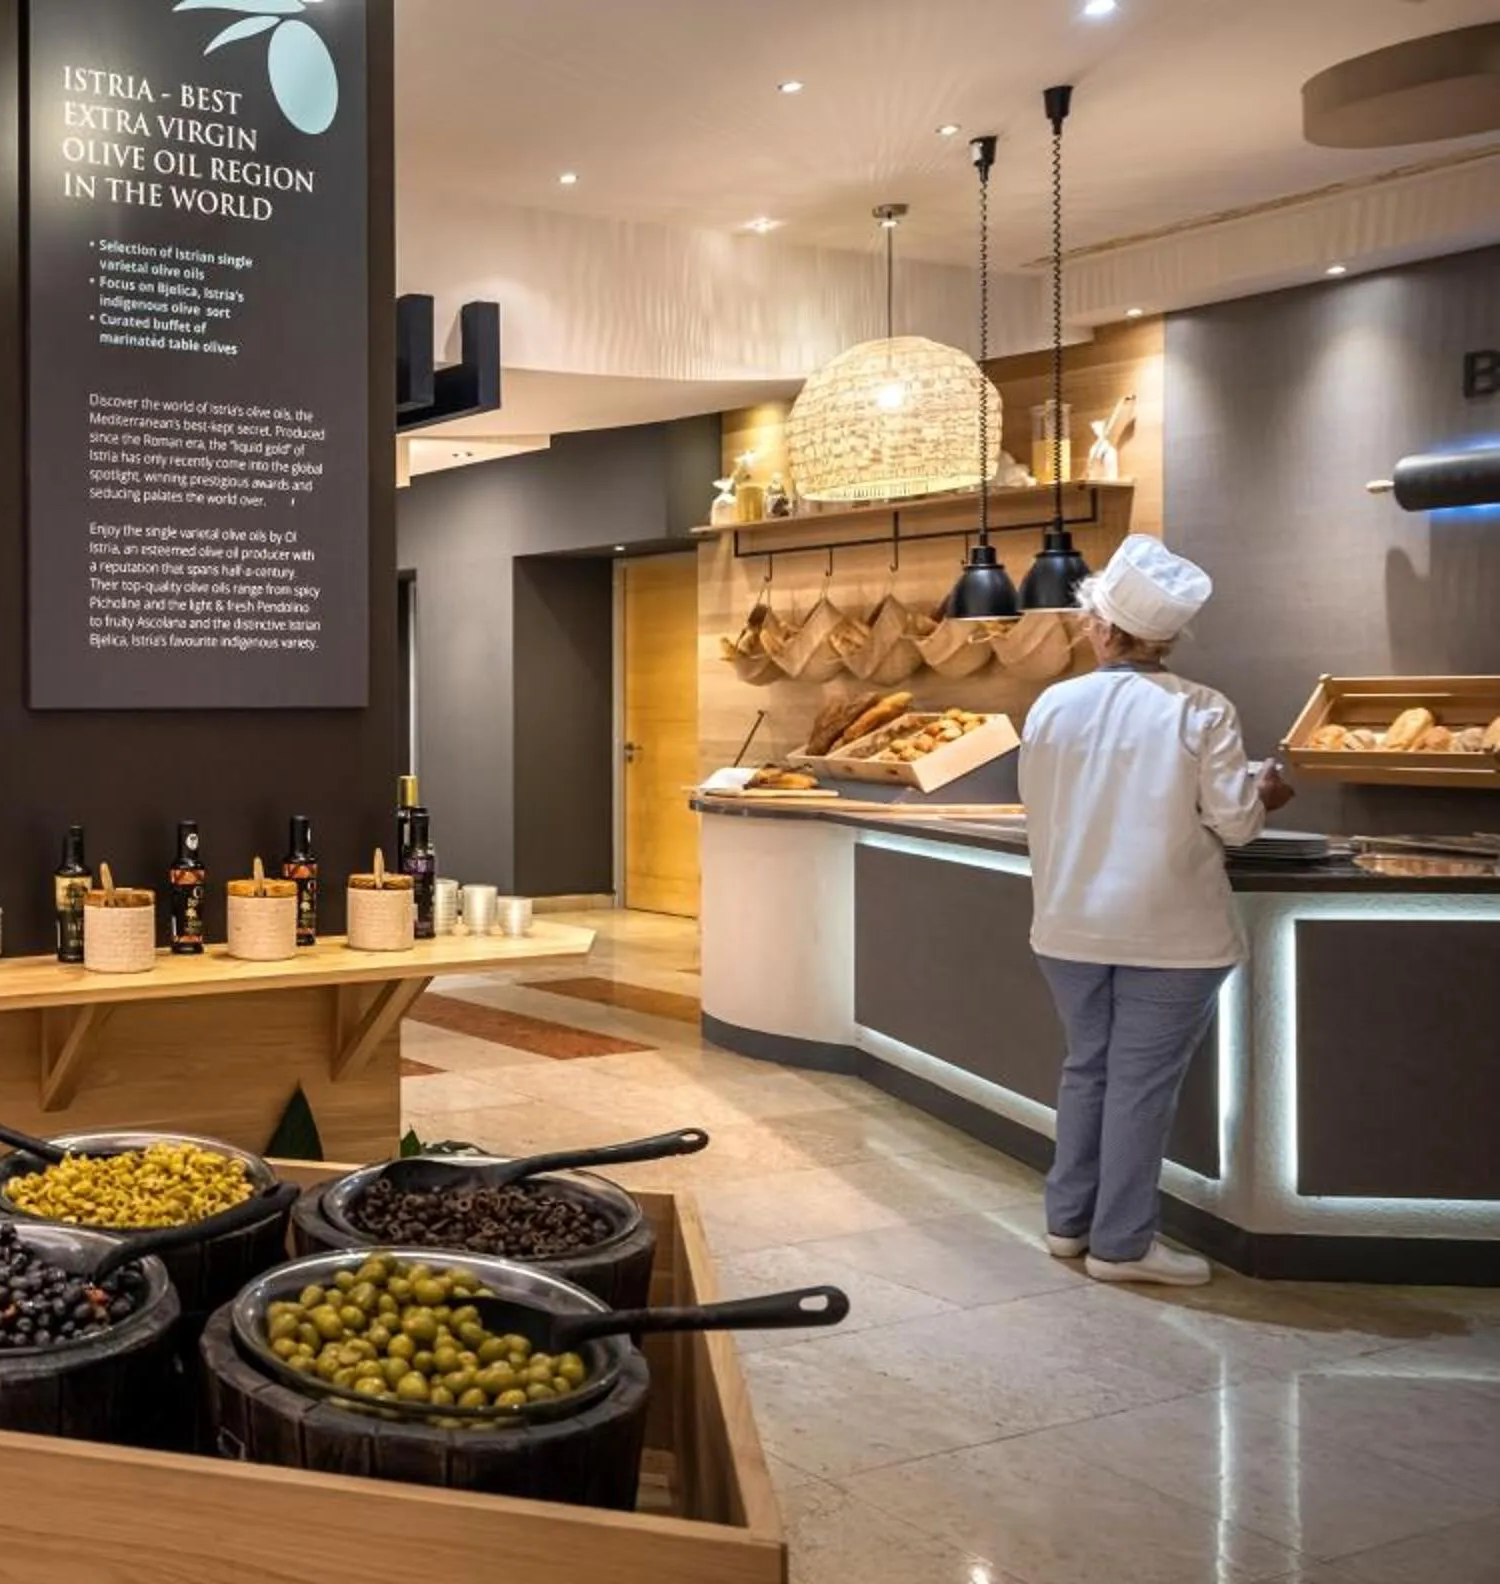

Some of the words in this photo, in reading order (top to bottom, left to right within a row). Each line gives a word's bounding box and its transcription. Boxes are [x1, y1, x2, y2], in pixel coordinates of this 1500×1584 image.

[63, 67, 153, 102] ISTRIA
[180, 83, 243, 114] BEST
[63, 102, 151, 136] EXTRA
[157, 114, 258, 151] VIRGIN
[61, 138, 145, 171] OLIVE
[153, 150, 203, 179] OIL
[210, 157, 314, 192] REGION
[63, 173, 95, 200] IN
[105, 178, 163, 208] THE
[169, 186, 272, 220] WORLD
[99, 239, 157, 257] Selection
[159, 246, 173, 259] of
[175, 247, 214, 264] Istrian
[217, 252, 253, 269] single
[99, 259, 148, 274] varietal
[151, 263, 180, 277] olive
[183, 266, 205, 280] oils
[99, 275, 135, 291] Focus
[138, 282, 154, 293] on
[157, 281, 201, 299] Bjelica,
[99, 294, 168, 312] indigenous
[171, 301, 200, 315] olive
[206, 306, 231, 318] sort
[99, 312, 150, 329] Curated
[153, 316, 191, 332] buffet
[193, 321, 207, 334] of
[99, 332, 165, 349] marinated
[168, 337, 199, 351] table
[202, 340, 237, 355] olives
